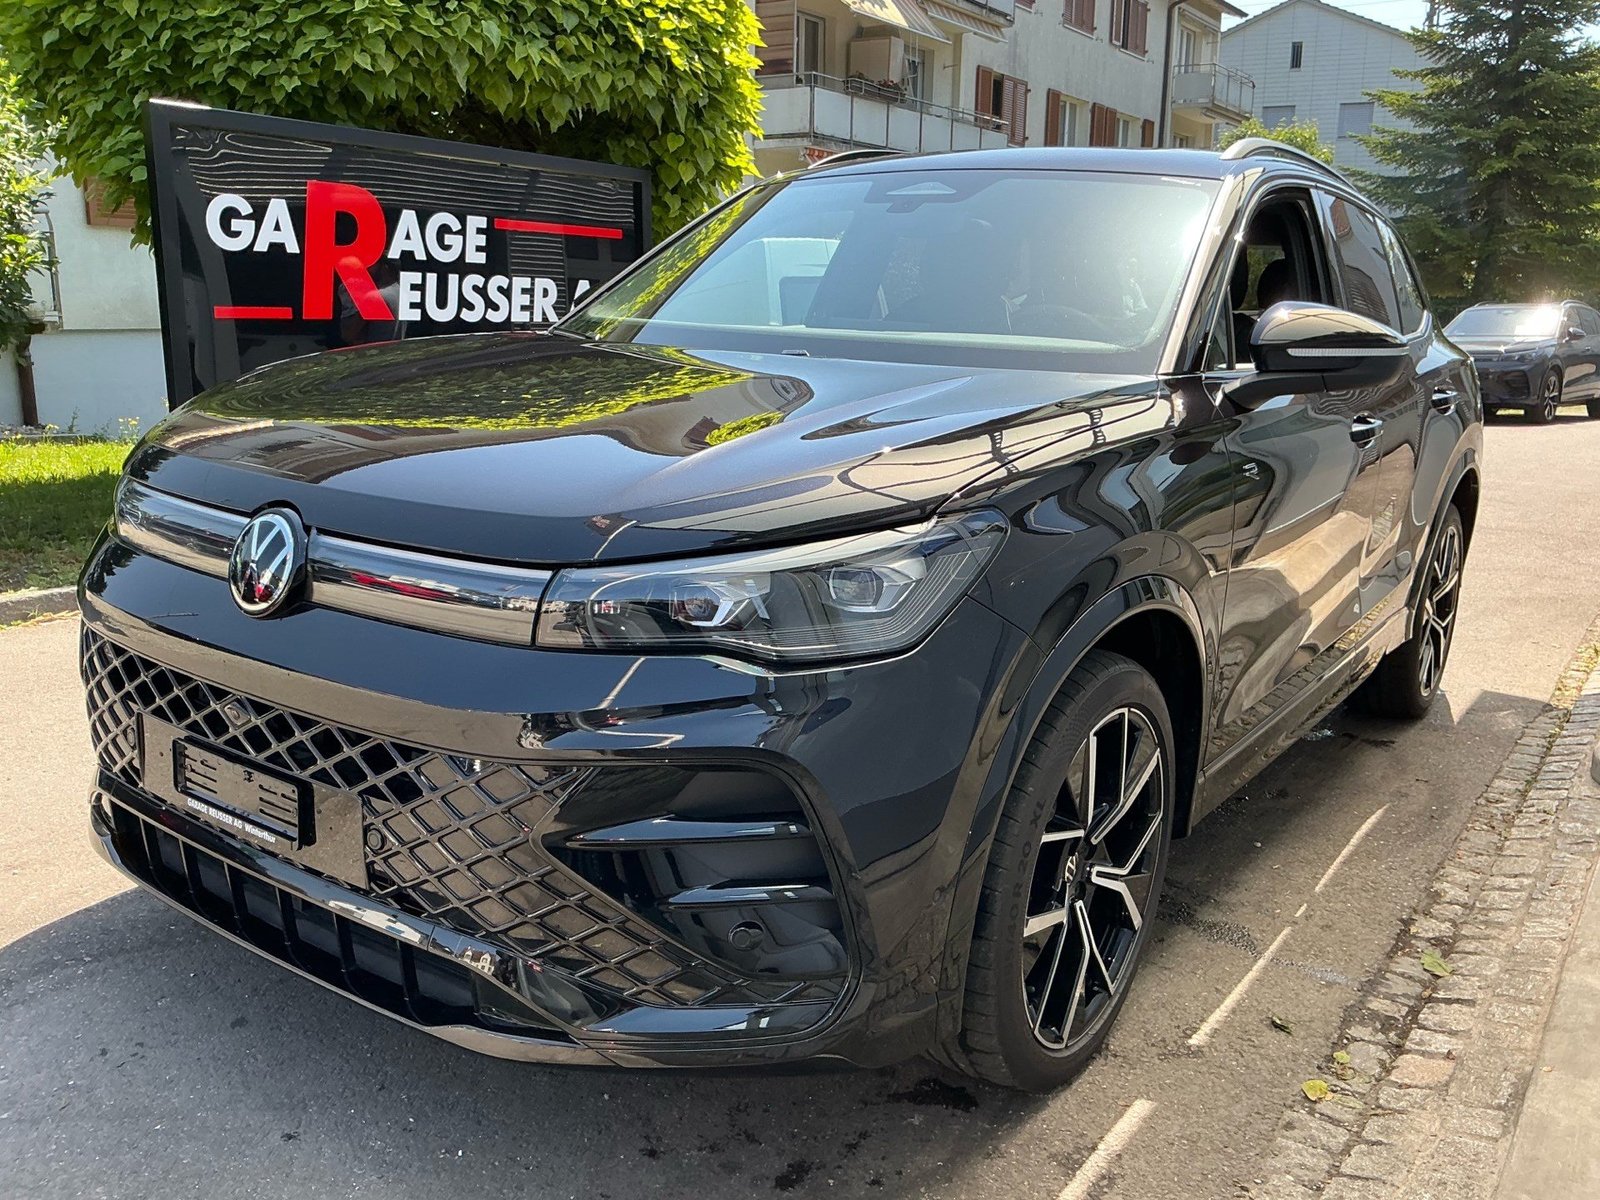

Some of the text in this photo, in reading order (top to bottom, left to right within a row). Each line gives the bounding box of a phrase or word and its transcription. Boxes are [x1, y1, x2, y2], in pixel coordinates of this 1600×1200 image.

[205, 181, 487, 321] GARAGE
[187, 798, 207, 814] GARAGE
[208, 807, 232, 825] REUSSER
[233, 819, 243, 829] AG
